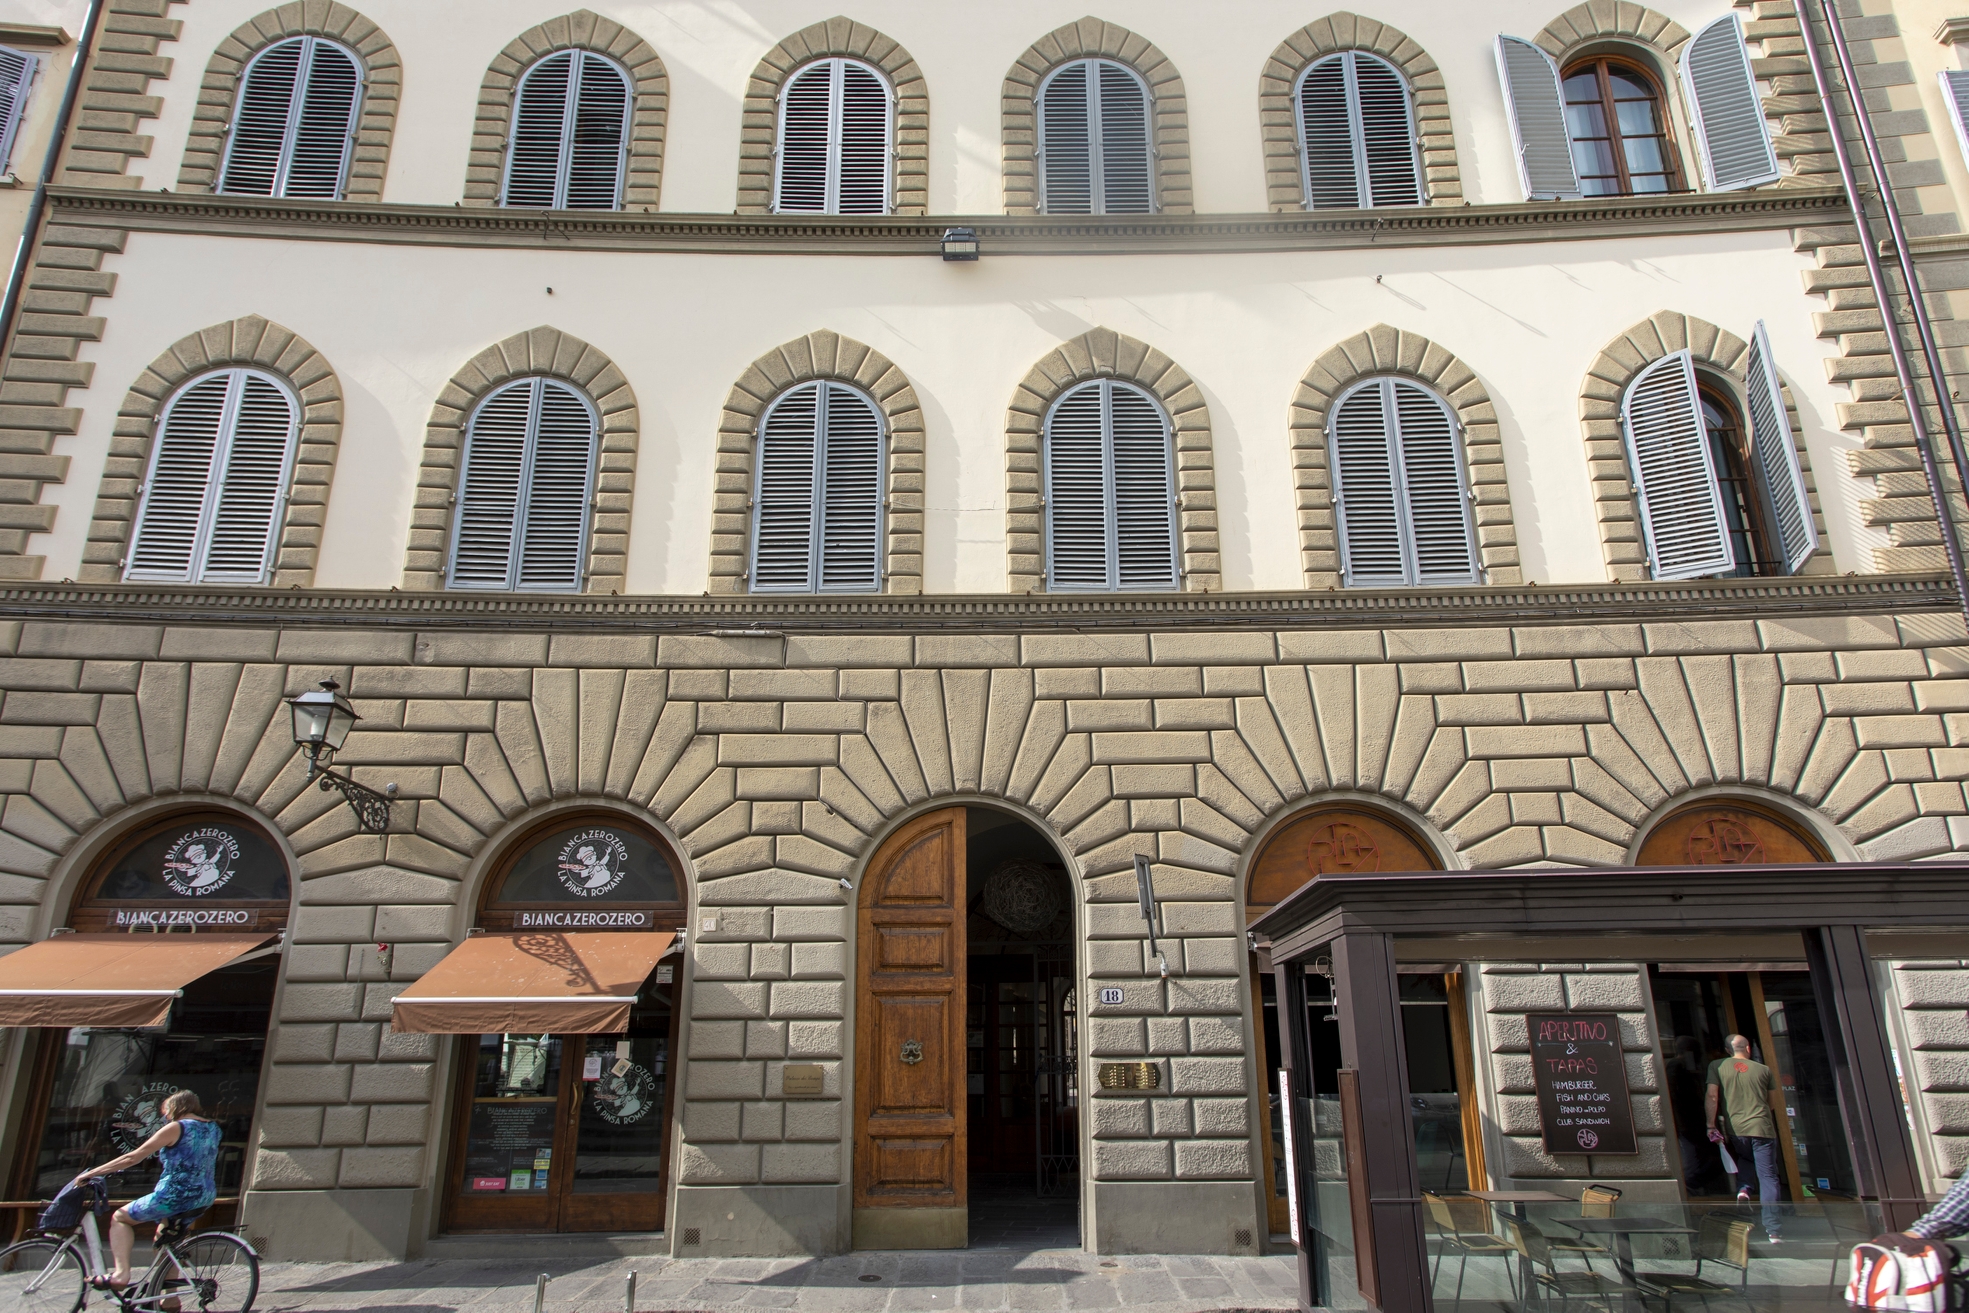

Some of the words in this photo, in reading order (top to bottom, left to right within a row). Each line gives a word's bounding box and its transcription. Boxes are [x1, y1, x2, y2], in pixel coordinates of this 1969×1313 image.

[164, 828, 240, 860] BIANCAZEROZERO
[558, 829, 628, 861] BIANCAZEROZERO
[162, 868, 172, 882] LA
[168, 880, 192, 896] PINSA
[195, 869, 236, 896] ROMANA
[557, 870, 567, 883] LA
[564, 880, 588, 897] PINSA
[591, 870, 626, 897] ROMANA
[116, 910, 248, 924] BIANCAZEROZERO
[522, 912, 645, 926] BIANCAZEROZERO
[1104, 990, 1119, 1002] 18
[1539, 1020, 1607, 1041] APERITIVO
[1566, 1042, 1578, 1055] &
[1546, 1057, 1598, 1075] TAPAS
[593, 1062, 656, 1091] BIANCROZERO
[1551, 1080, 1597, 1090] HAMBURGER
[1556, 1093, 1574, 1102] FISH
[1577, 1093, 1591, 1101] AND
[1592, 1093, 1611, 1102] CHIPS
[593, 1100, 602, 1112] LA
[600, 1110, 620, 1125] PINSA
[623, 1100, 654, 1125] ROMANA
[1560, 1105, 1583, 1114] PANINO
[1556, 1117, 1574, 1126] CLUB
